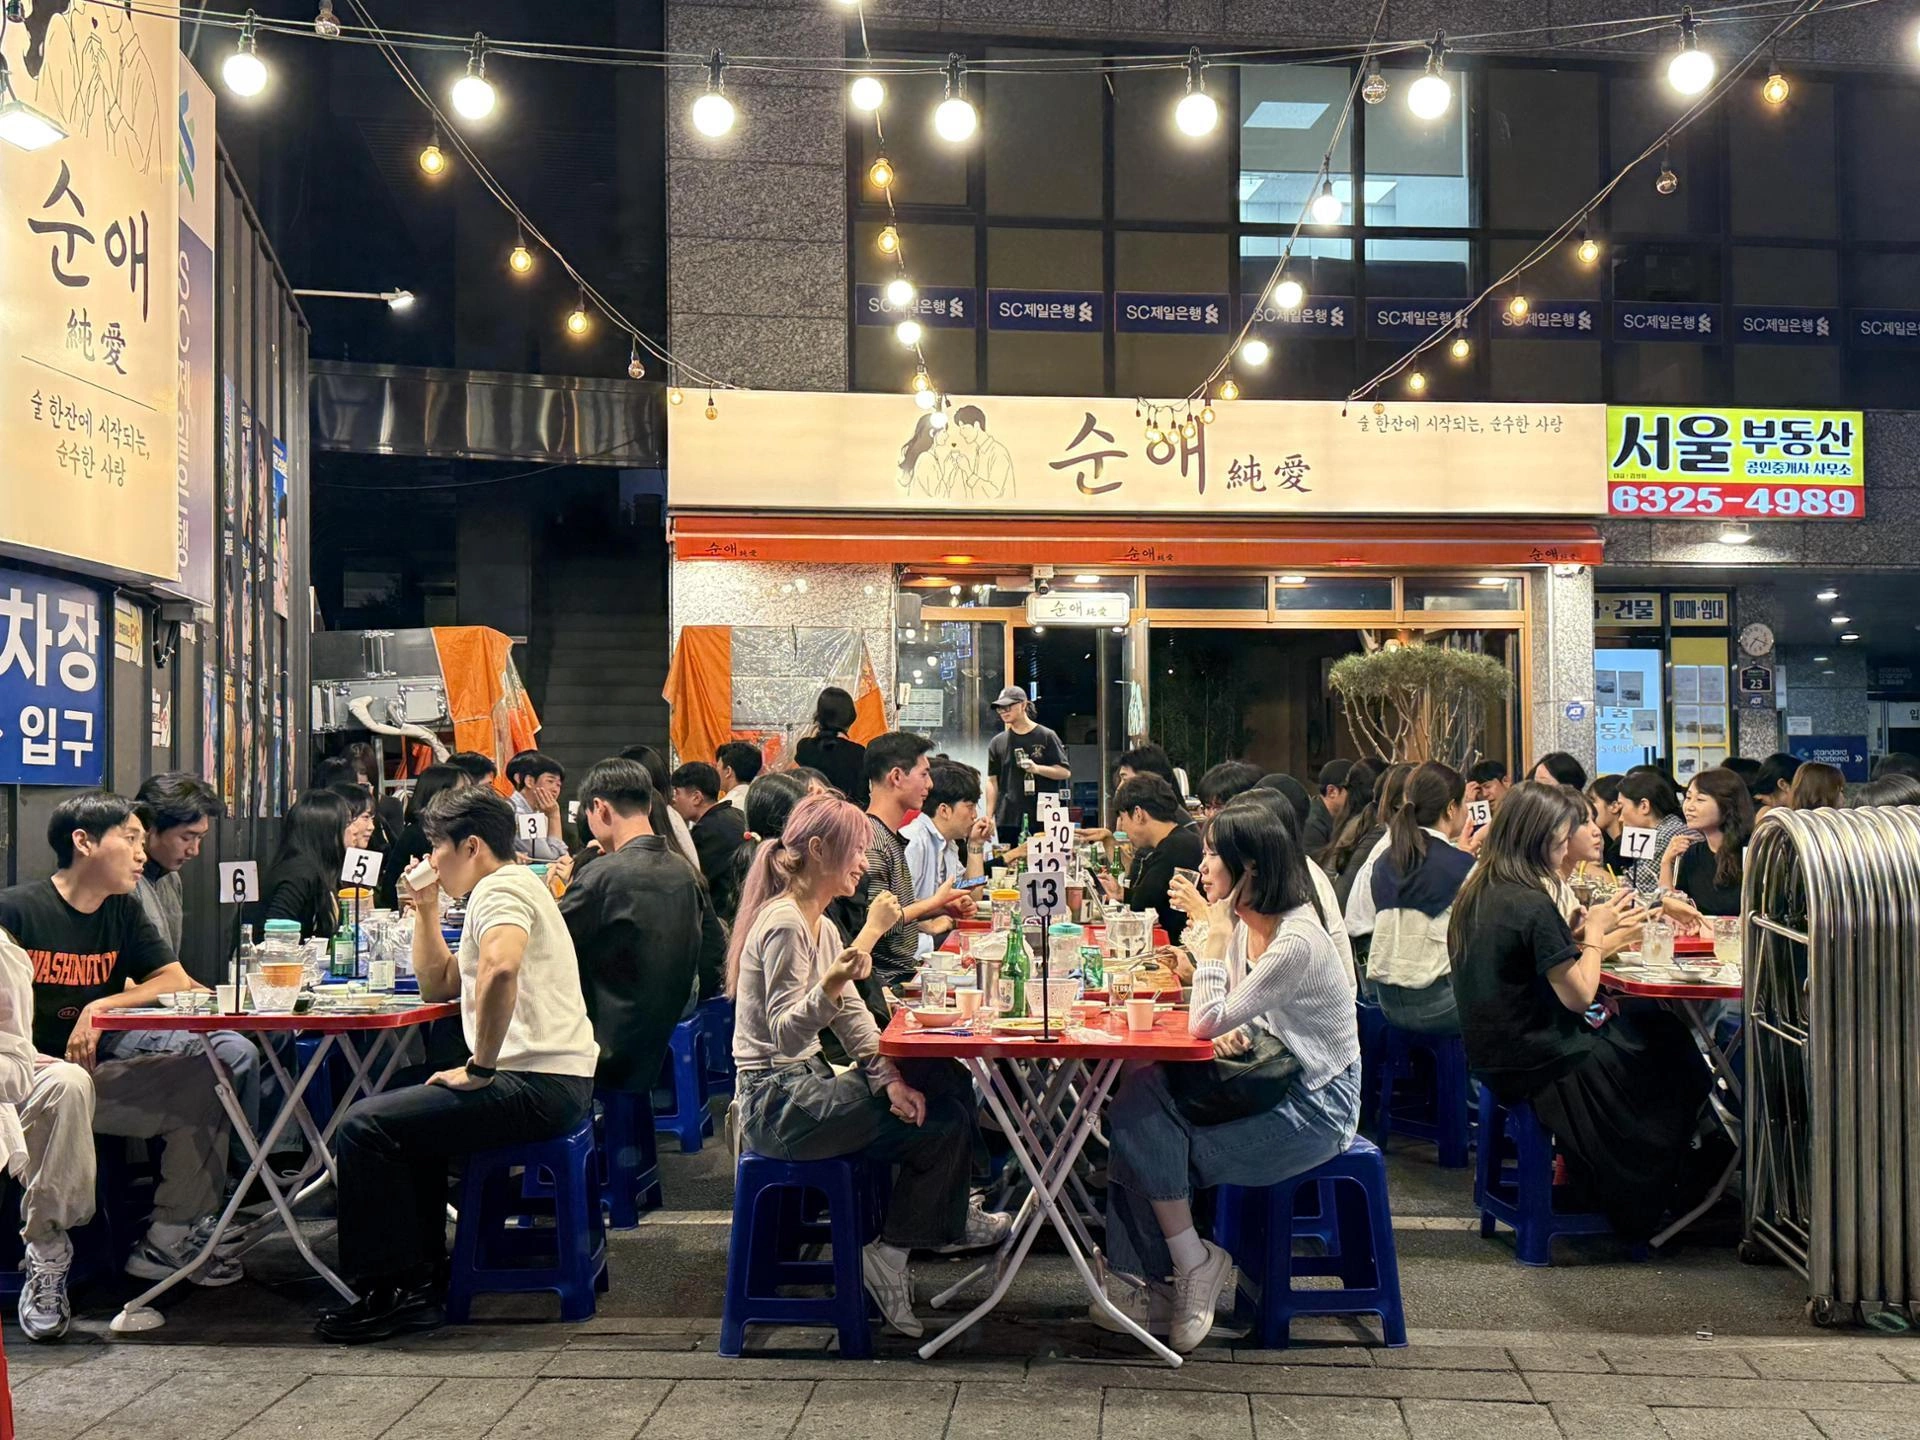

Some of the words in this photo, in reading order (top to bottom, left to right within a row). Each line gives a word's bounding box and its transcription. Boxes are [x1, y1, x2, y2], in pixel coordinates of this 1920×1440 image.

[27, 159, 149, 323] 순애
[999, 302, 1075, 319] SC제일은행
[1126, 304, 1202, 321] SC제일은행
[1254, 307, 1328, 325] SC제일은행
[1377, 310, 1452, 326] SC제일은행
[1623, 313, 1696, 330] SC제일은행
[1743, 317, 1814, 334] SC제일은행
[1860, 321, 1920, 337] SC제일은
[66, 308, 127, 375] 純愛
[30, 389, 43, 421] 술
[49, 394, 93, 439] 한잔에
[1357, 415, 1369, 432] 술
[1375, 414, 1419, 433] 한잔에
[1489, 415, 1530, 434] 순수한
[1535, 415, 1563, 433] 사랑
[1048, 411, 1206, 495] 순애
[1613, 415, 1732, 473] 서울
[1742, 419, 1853, 456] 부동산
[56, 439, 96, 479] 순수한
[100, 453, 126, 487] 사랑
[1226, 453, 1312, 493] 純愛
[1746, 461, 1810, 475] 공인중개사
[1813, 461, 1851, 475] 사무소
[1612, 486, 1855, 514] 6325-4989
[1050, 600, 1082, 617] 순애
[1750, 679, 1763, 689] 23
[20, 705, 94, 767] 입구
[1468, 805, 1486, 821] 15
[528, 817, 537, 834] 3
[1050, 826, 1069, 845] 10
[1627, 832, 1651, 853] 17
[354, 855, 369, 878] 5
[232, 868, 246, 895] 6
[1026, 878, 1059, 909] 13
